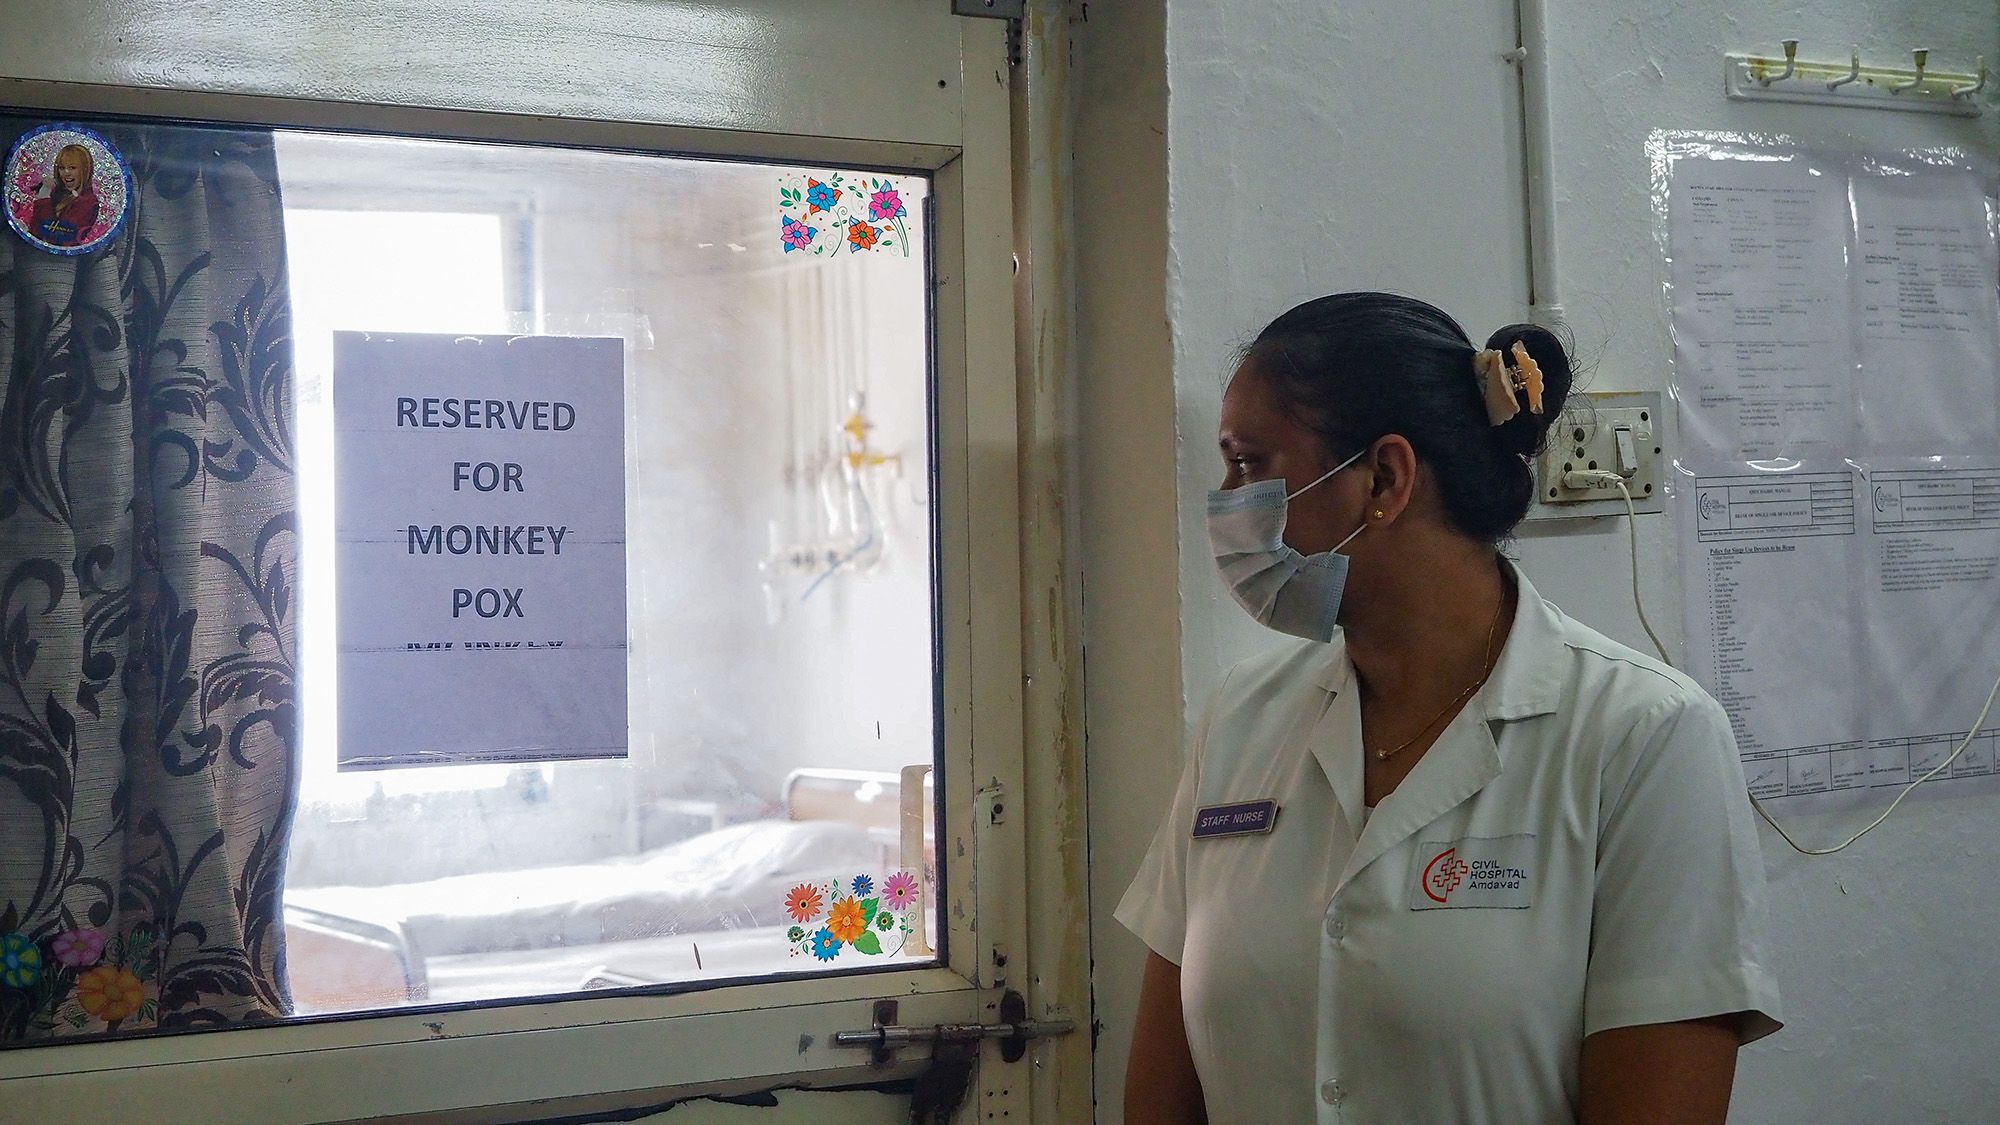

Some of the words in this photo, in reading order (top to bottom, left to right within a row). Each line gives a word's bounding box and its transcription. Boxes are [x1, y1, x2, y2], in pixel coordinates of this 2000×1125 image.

[397, 397, 576, 431] RESERVED
[453, 462, 524, 492] FOR
[407, 525, 567, 555] MONKEY
[452, 588, 524, 618] POX
[1201, 814, 1231, 828] STAFF
[1232, 810, 1265, 824] NURSE
[1470, 868, 1527, 880] HOSPITAL
[1471, 860, 1500, 870] CIVIL
[1468, 880, 1520, 890] Amdavad
